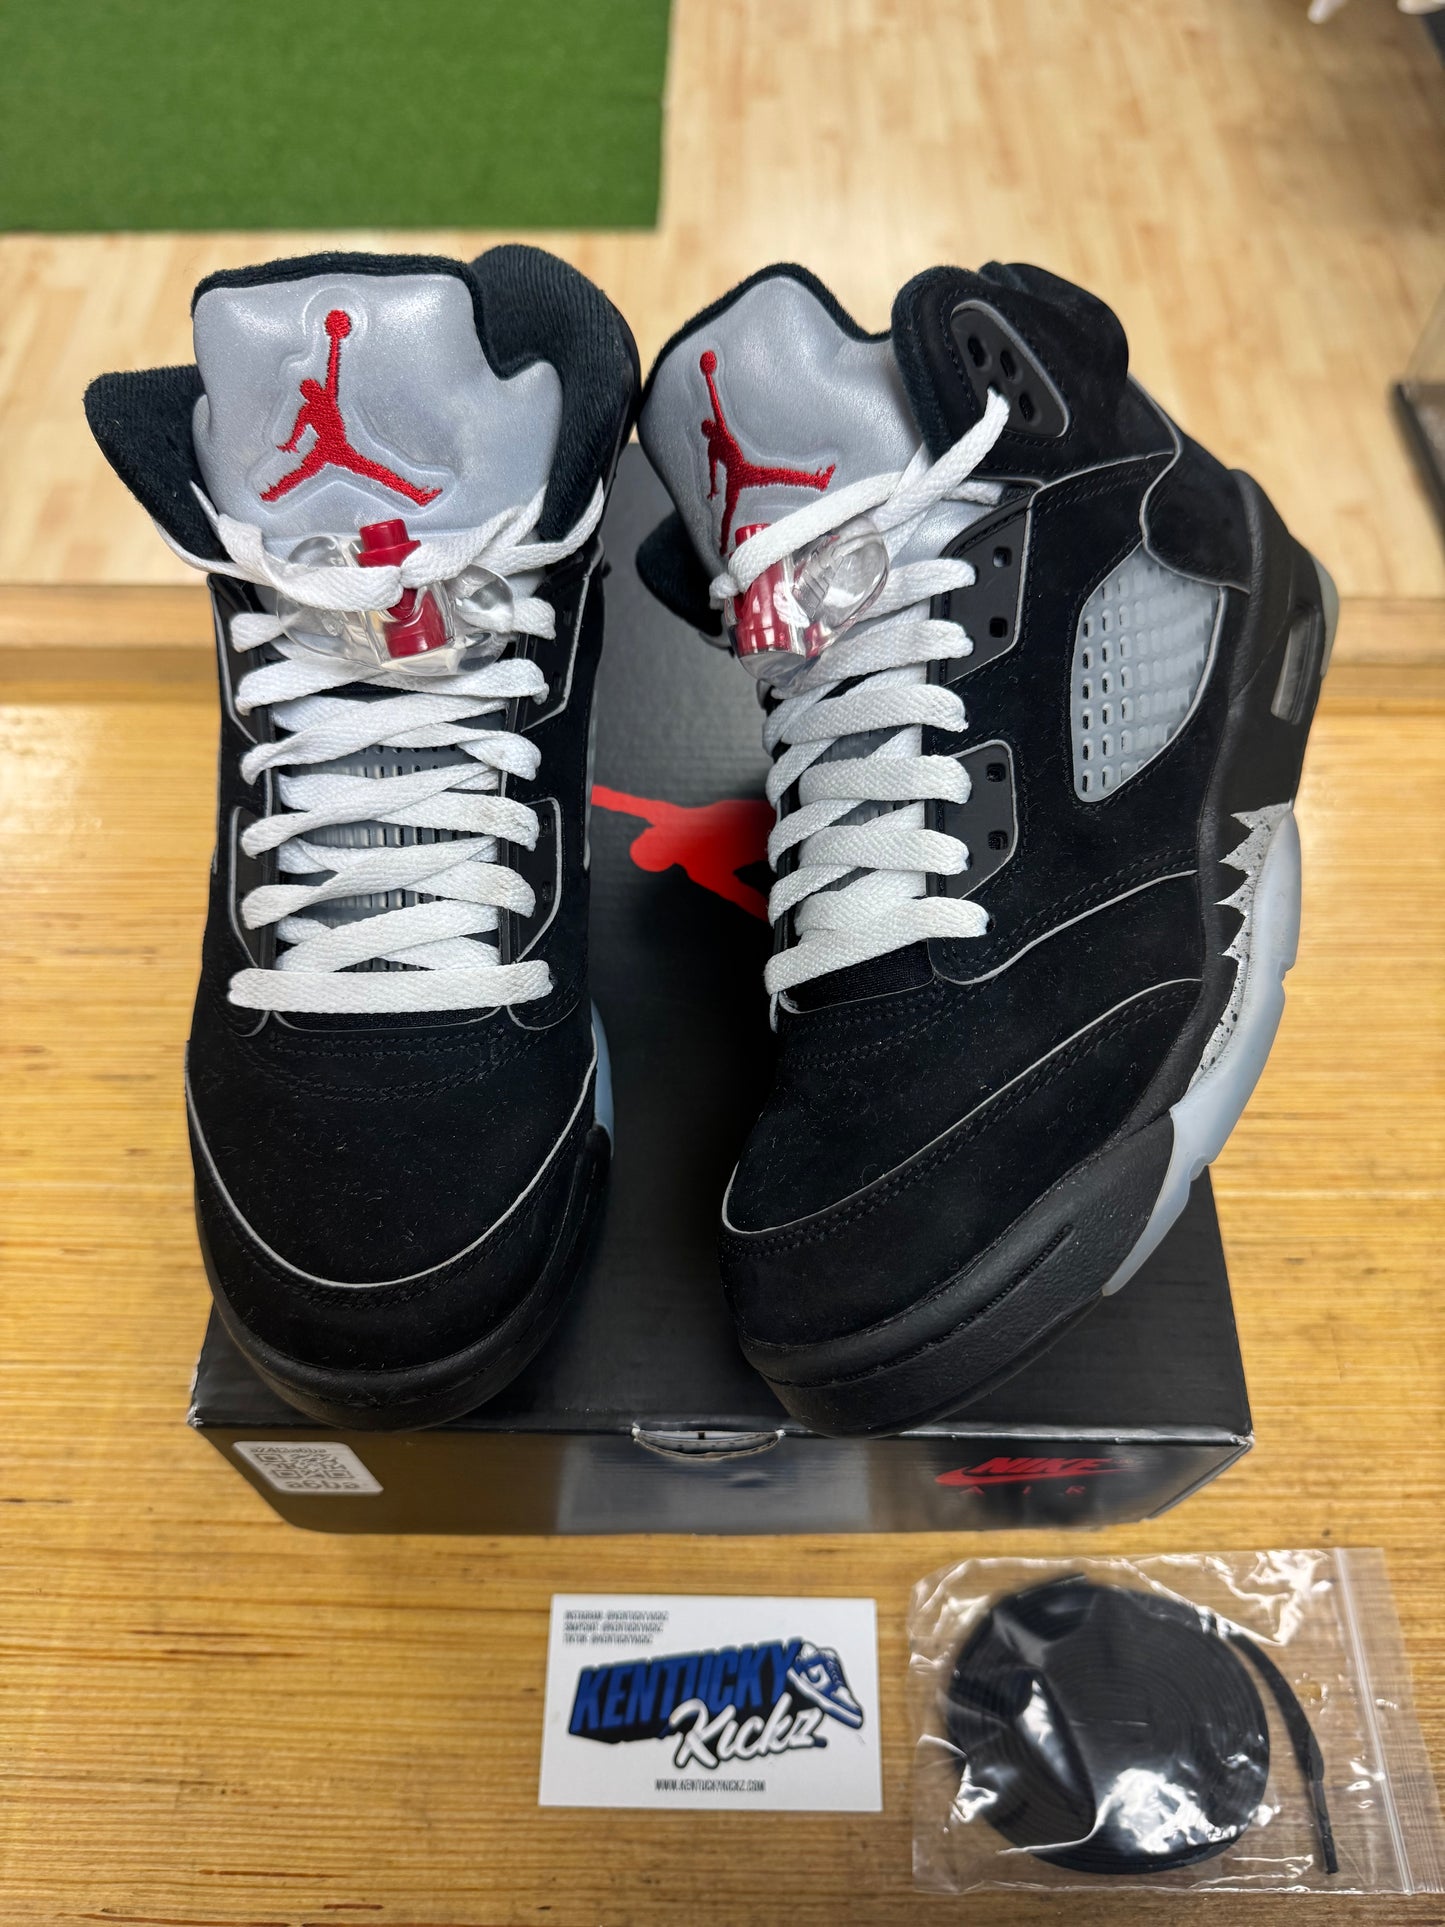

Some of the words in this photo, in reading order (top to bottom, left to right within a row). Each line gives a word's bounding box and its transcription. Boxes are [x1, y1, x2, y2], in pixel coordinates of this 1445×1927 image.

[967, 1457, 1115, 1474] NIKE
[570, 1638, 802, 1735] KENTUCKY
[668, 1692, 827, 1769] Kickz
